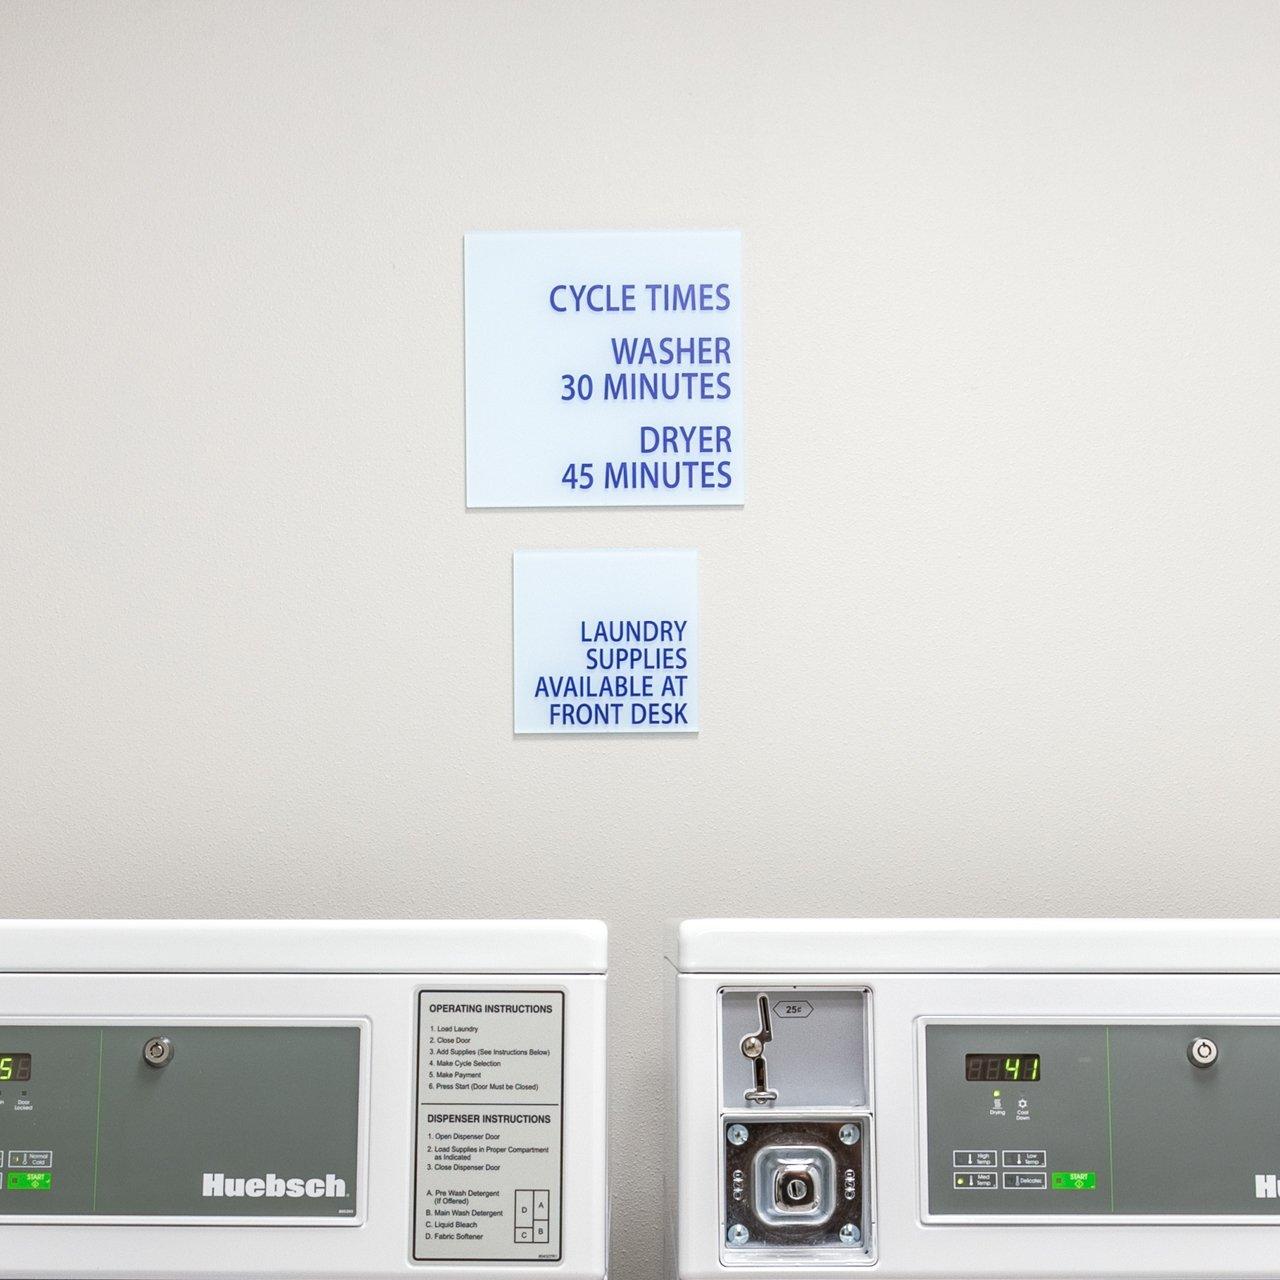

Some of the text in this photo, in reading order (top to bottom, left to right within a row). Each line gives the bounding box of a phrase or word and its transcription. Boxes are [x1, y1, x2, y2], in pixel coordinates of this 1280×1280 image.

[549, 283, 731, 312] CYCLE TIMES
[611, 337, 732, 364] WASHER
[560, 372, 732, 401] 30 MINUTES
[640, 426, 732, 453] DRYER
[561, 461, 732, 490] 45 MINUTES
[581, 621, 688, 642] LAUNDRY
[586, 648, 688, 669] SUPPLIES
[534, 676, 688, 698] AVAILABLE AT
[549, 703, 689, 725] FRONT DESK
[429, 1004, 553, 1013] OPERATING INSTRUCTIONS
[455, 1060, 471, 1068] Cycle
[1005, 1058, 1038, 1080] 41
[428, 1114, 551, 1124] DISPENSER INSTRUCTIONS
[453, 1133, 484, 1141] Dispenser
[453, 1164, 484, 1172] Dispenser
[202, 1173, 346, 1198] Huebsch
[468, 1190, 499, 1198] Detergent
